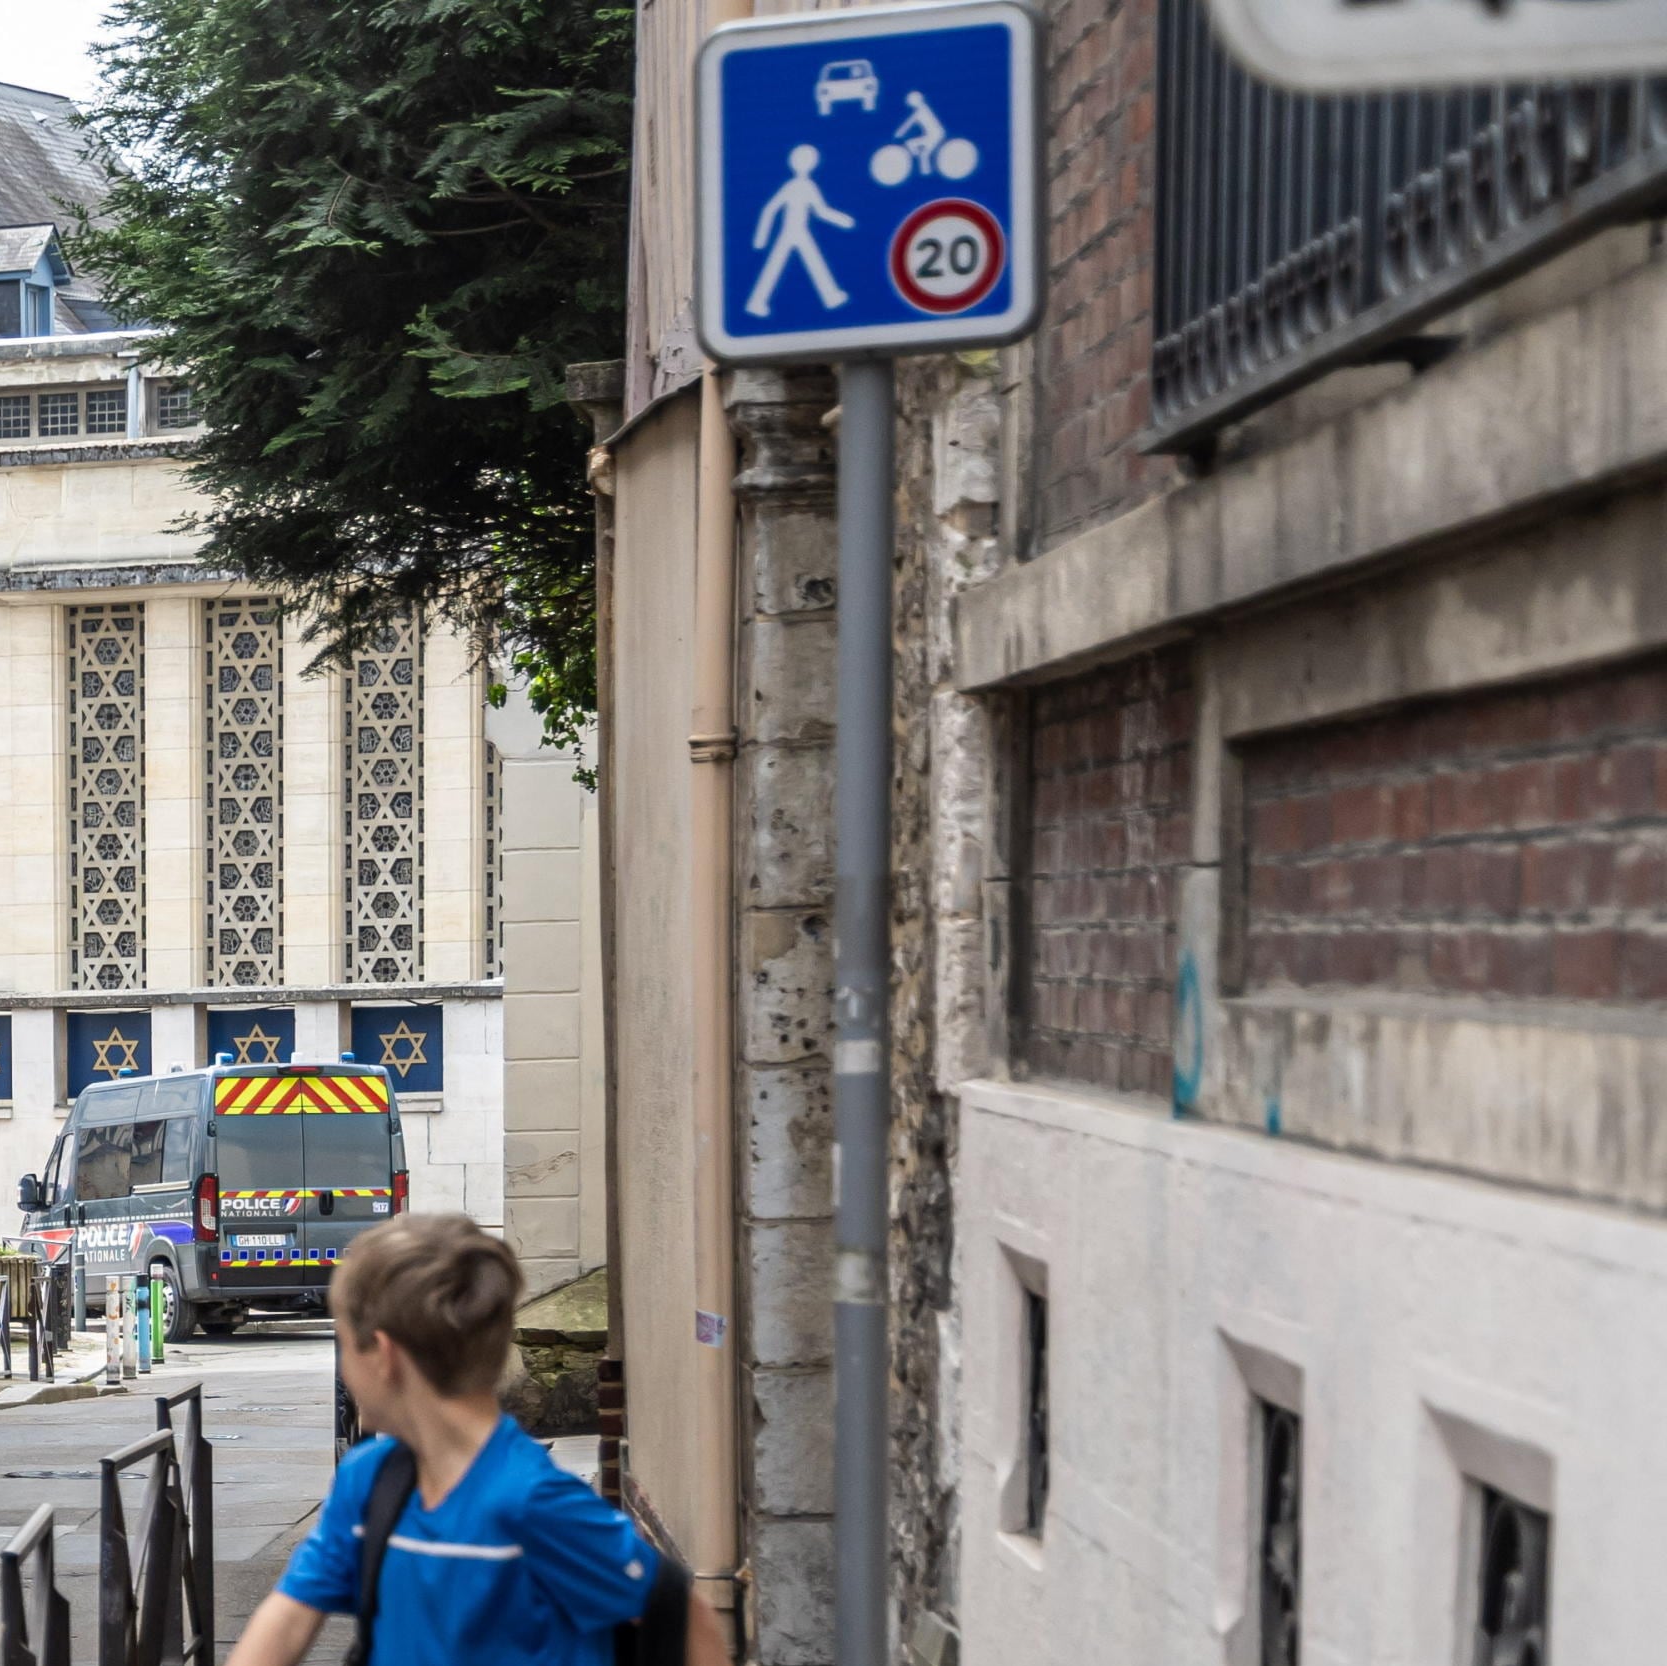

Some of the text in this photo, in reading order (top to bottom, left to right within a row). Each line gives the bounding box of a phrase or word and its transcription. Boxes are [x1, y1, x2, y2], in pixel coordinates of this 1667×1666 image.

[914, 235, 979, 279] 20
[221, 1198, 280, 1210] POLICE
[77, 1223, 127, 1249] POLICE
[84, 1249, 126, 1263] ATIONALE
